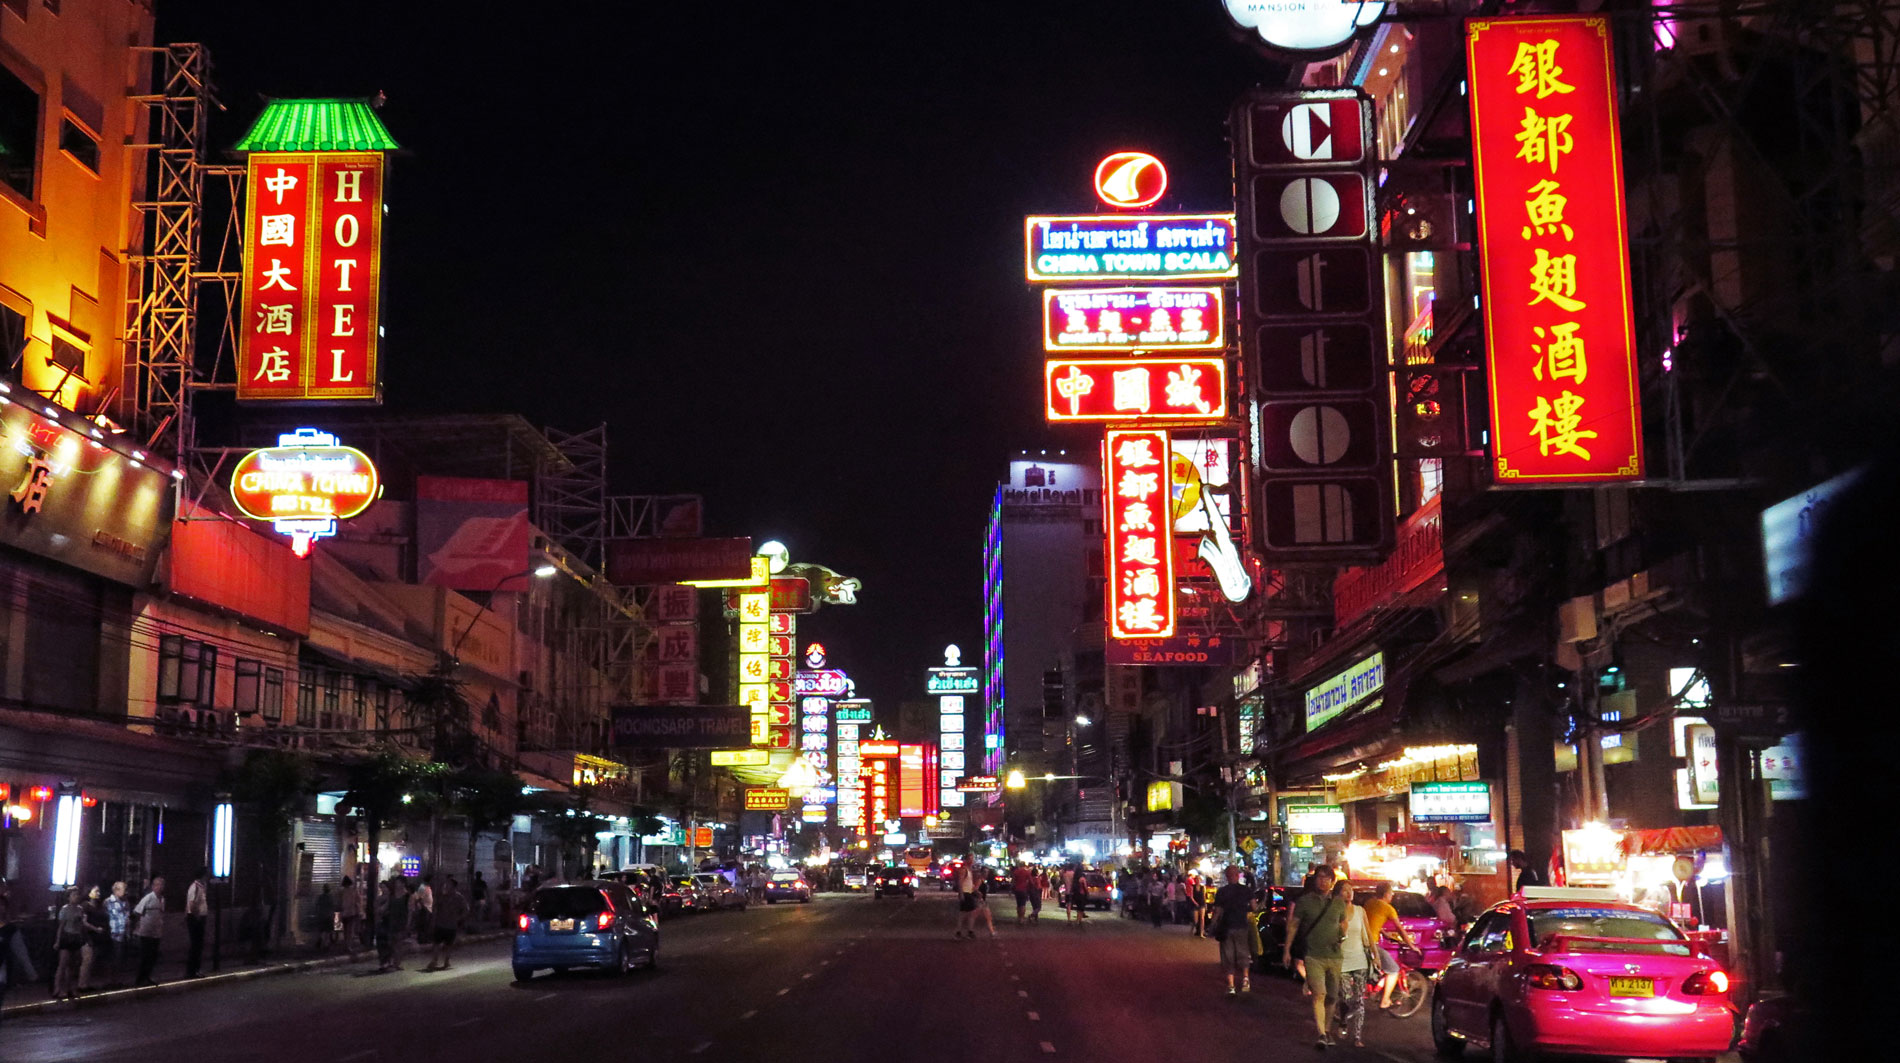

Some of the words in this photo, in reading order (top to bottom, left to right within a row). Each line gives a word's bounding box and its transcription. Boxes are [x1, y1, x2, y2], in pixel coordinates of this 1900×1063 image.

[1247, 2, 1306, 12] MANSION
[1507, 38, 1598, 461] 銀都魚翅酒樓
[1038, 254, 1099, 273] CHINA
[1102, 253, 1161, 272] TOWN
[1164, 252, 1230, 271] SCALA
[253, 168, 298, 383] 中國大酒店
[329, 170, 364, 383] HOTEL
[1056, 364, 1210, 416] 中國城
[241, 472, 304, 493] CHINA
[311, 472, 369, 494] TOWN
[1004, 488, 1041, 503] Hotel
[1043, 488, 1081, 504] Royal
[1115, 438, 1165, 631] 銀都魚翅酒樓
[1133, 652, 1209, 663] SEAFOOD
[699, 718, 746, 735] TRAVEL
